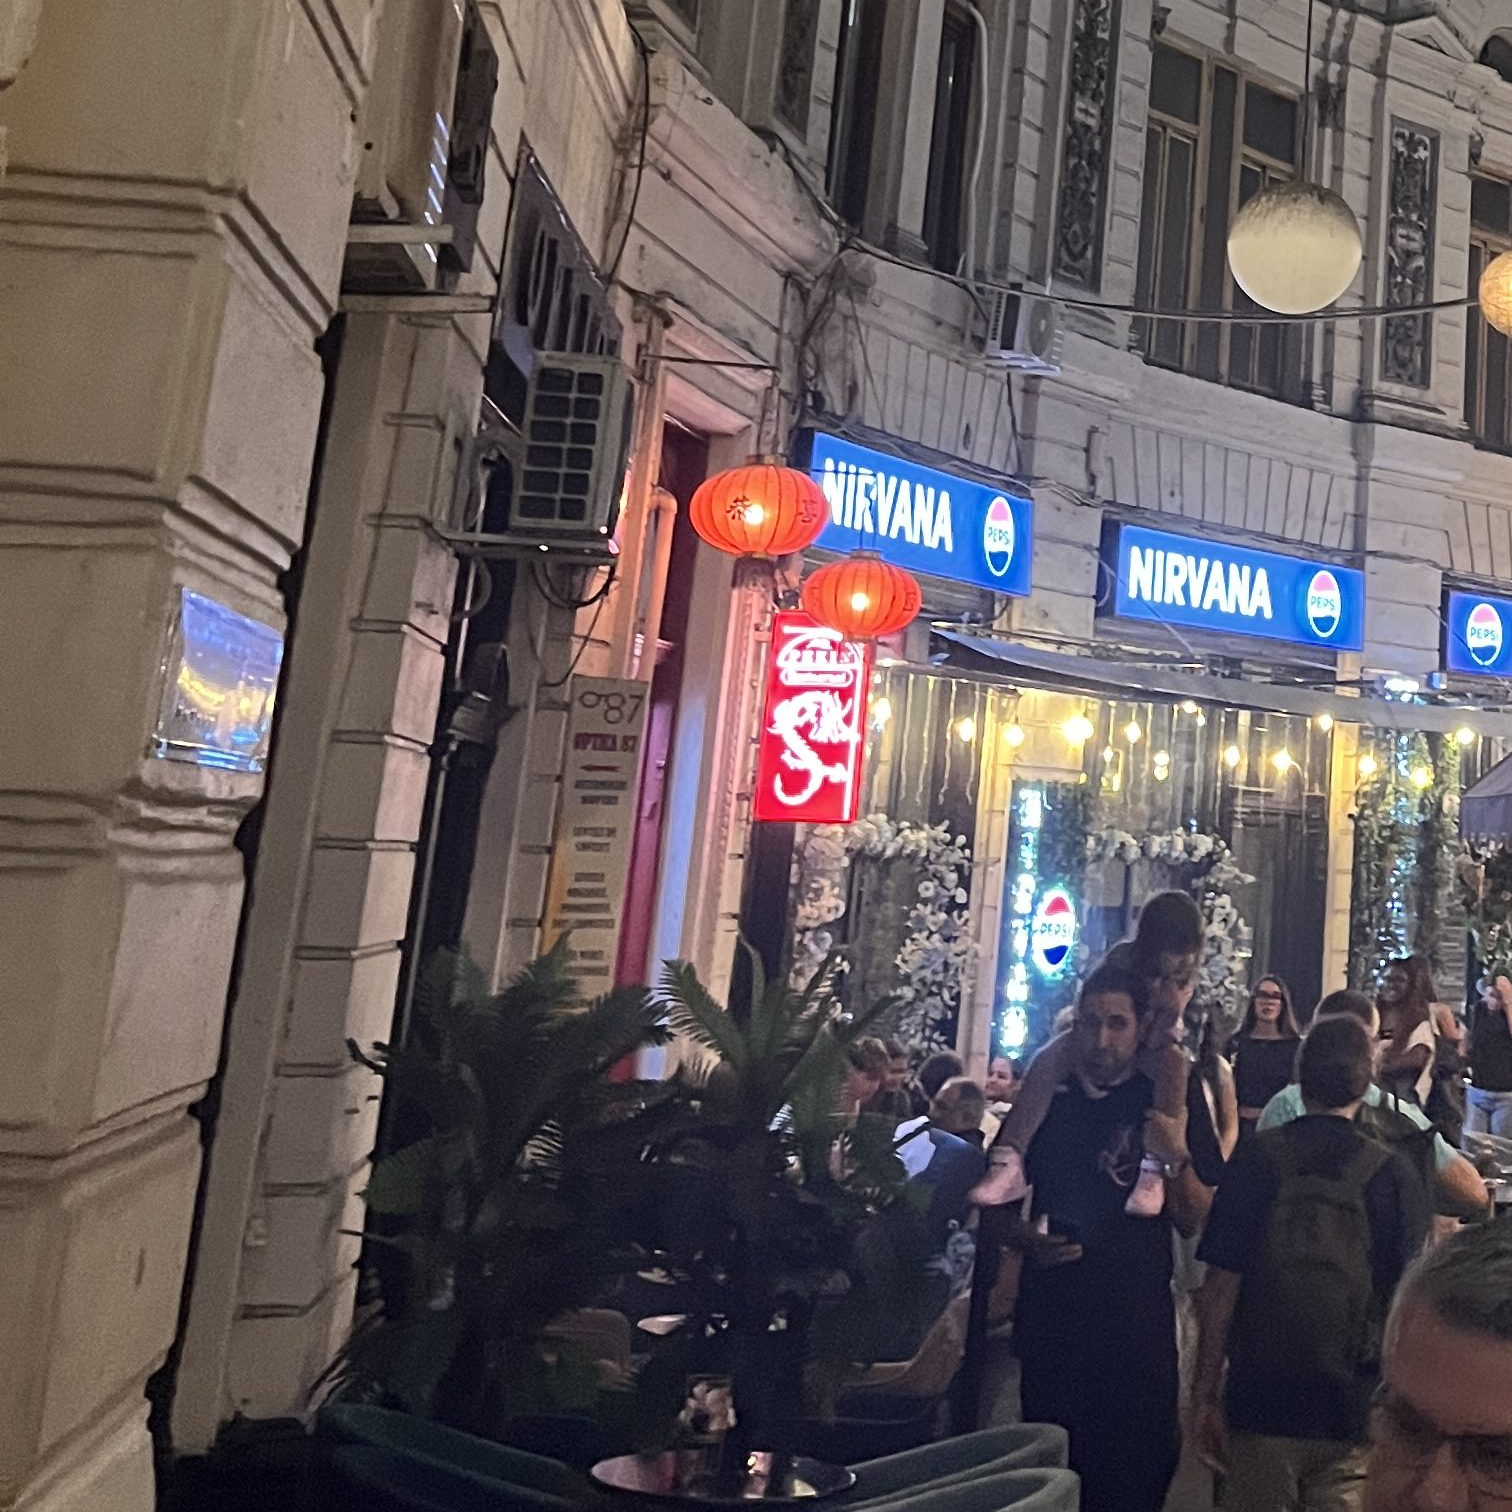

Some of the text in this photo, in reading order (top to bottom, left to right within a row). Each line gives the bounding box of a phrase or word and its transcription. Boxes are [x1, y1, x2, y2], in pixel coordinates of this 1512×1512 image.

[822, 456, 953, 553] NIRVANA
[987, 526, 1011, 546] PEPS
[1128, 545, 1273, 620] NIRVANA
[1310, 595, 1337, 611] PEPS
